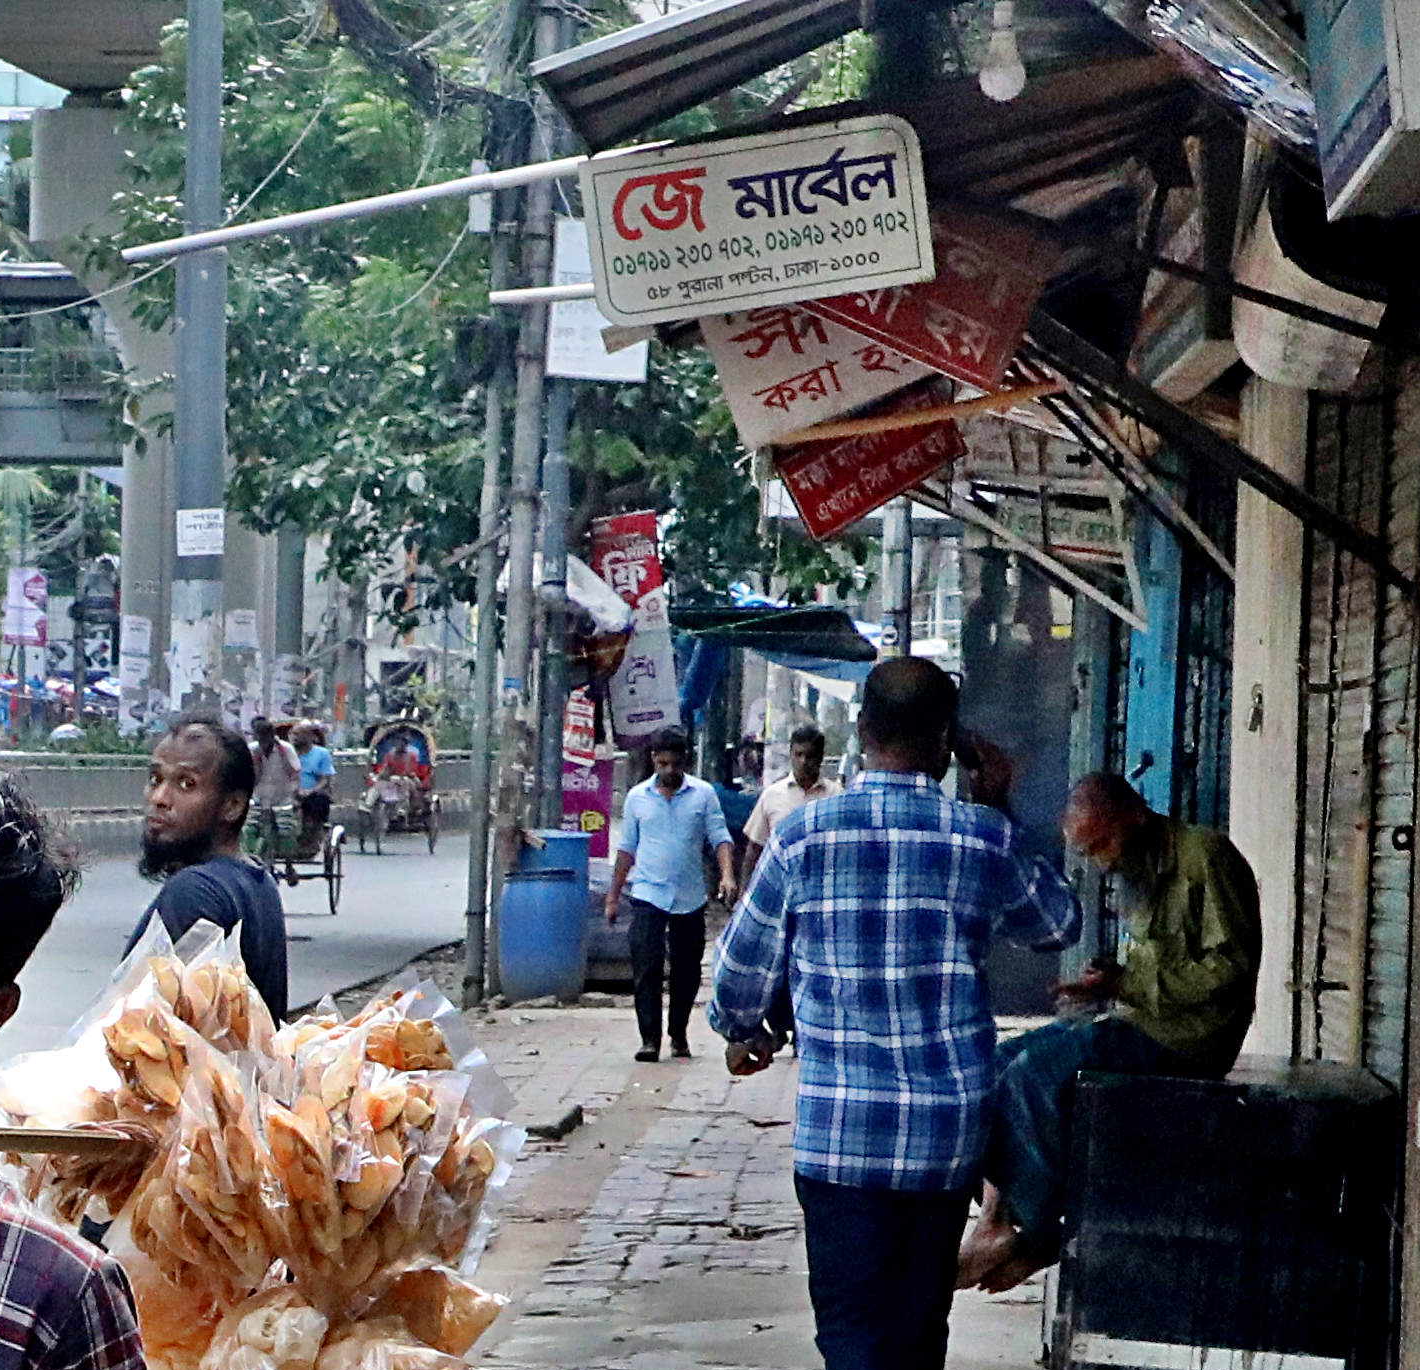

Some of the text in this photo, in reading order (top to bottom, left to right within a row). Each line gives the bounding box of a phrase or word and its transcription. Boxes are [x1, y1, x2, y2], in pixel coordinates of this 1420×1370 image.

[612, 146, 898, 241] জে মার্বেল
[613, 210, 911, 277] ০১৭১১ ২৩০ ৭০২, ০১৯৭১ ২৩০ ৭০২
[647, 286, 673, 300] ৫৮
[677, 274, 725, 301] পুরানা
[783, 251, 881, 282] ঢাকা-১০০০
[752, 345, 911, 411] করা হ
